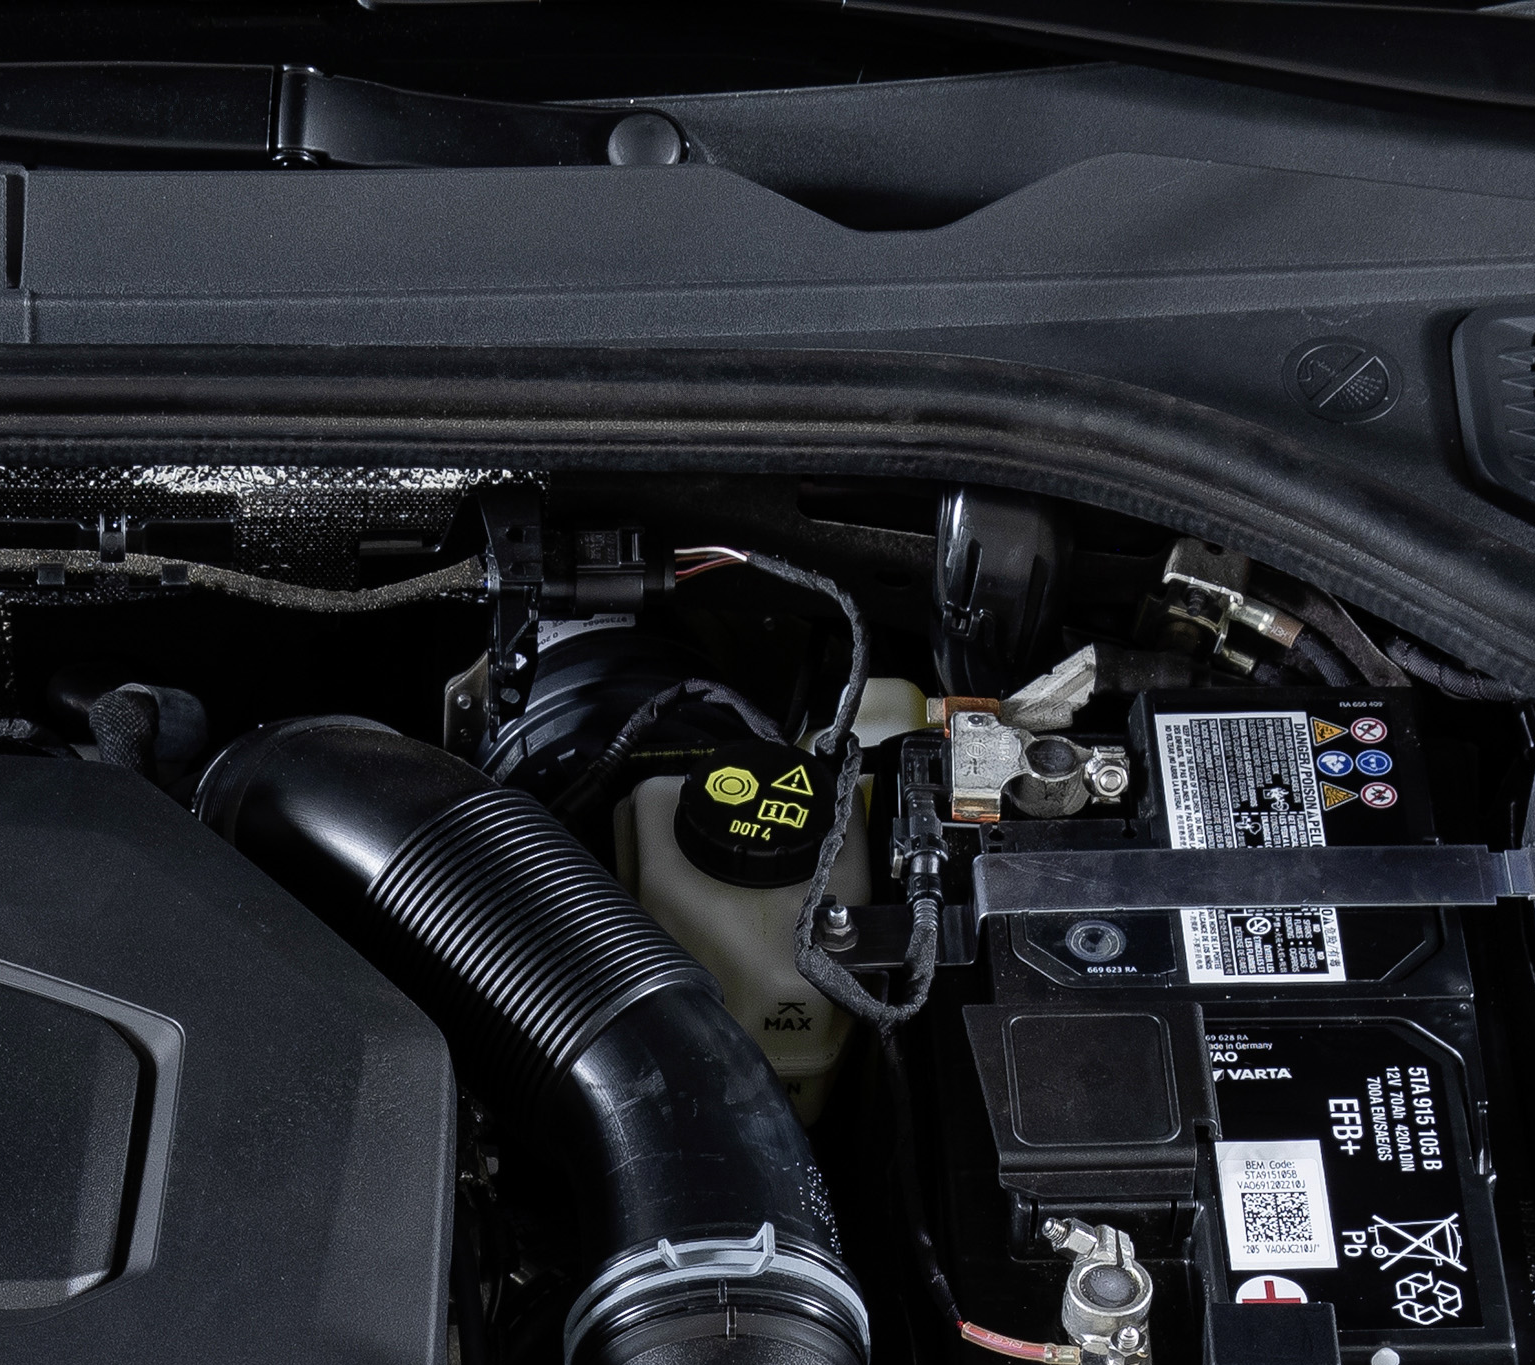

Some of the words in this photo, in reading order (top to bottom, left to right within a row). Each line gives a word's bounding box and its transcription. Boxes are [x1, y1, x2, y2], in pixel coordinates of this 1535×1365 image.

[730, 820, 761, 837] DOT
[762, 825, 772, 841] 4
[1209, 1042, 1224, 1050] ade
[1225, 1042, 1234, 1050] in
[1235, 1042, 1273, 1051] Germany
[1227, 1067, 1293, 1080] VARTA
[1386, 1066, 1402, 1087] 12V
[1407, 1066, 1430, 1095] 5TA
[1366, 1076, 1384, 1105] 700A
[1389, 1091, 1404, 1119] 70Ah
[1413, 1098, 1436, 1126] 915
[1328, 1098, 1363, 1156] EFB+
[1371, 1106, 1392, 1161] EN/SAE/GS
[1394, 1124, 1411, 1153] 420A
[1418, 1129, 1440, 1156] 105
[1245, 1160, 1265, 1170] BEM
[1269, 1160, 1296, 1169] Code:
[1399, 1154, 1415, 1173] DIN
[1423, 1159, 1442, 1170] B
[1341, 1230, 1368, 1258] Pb
